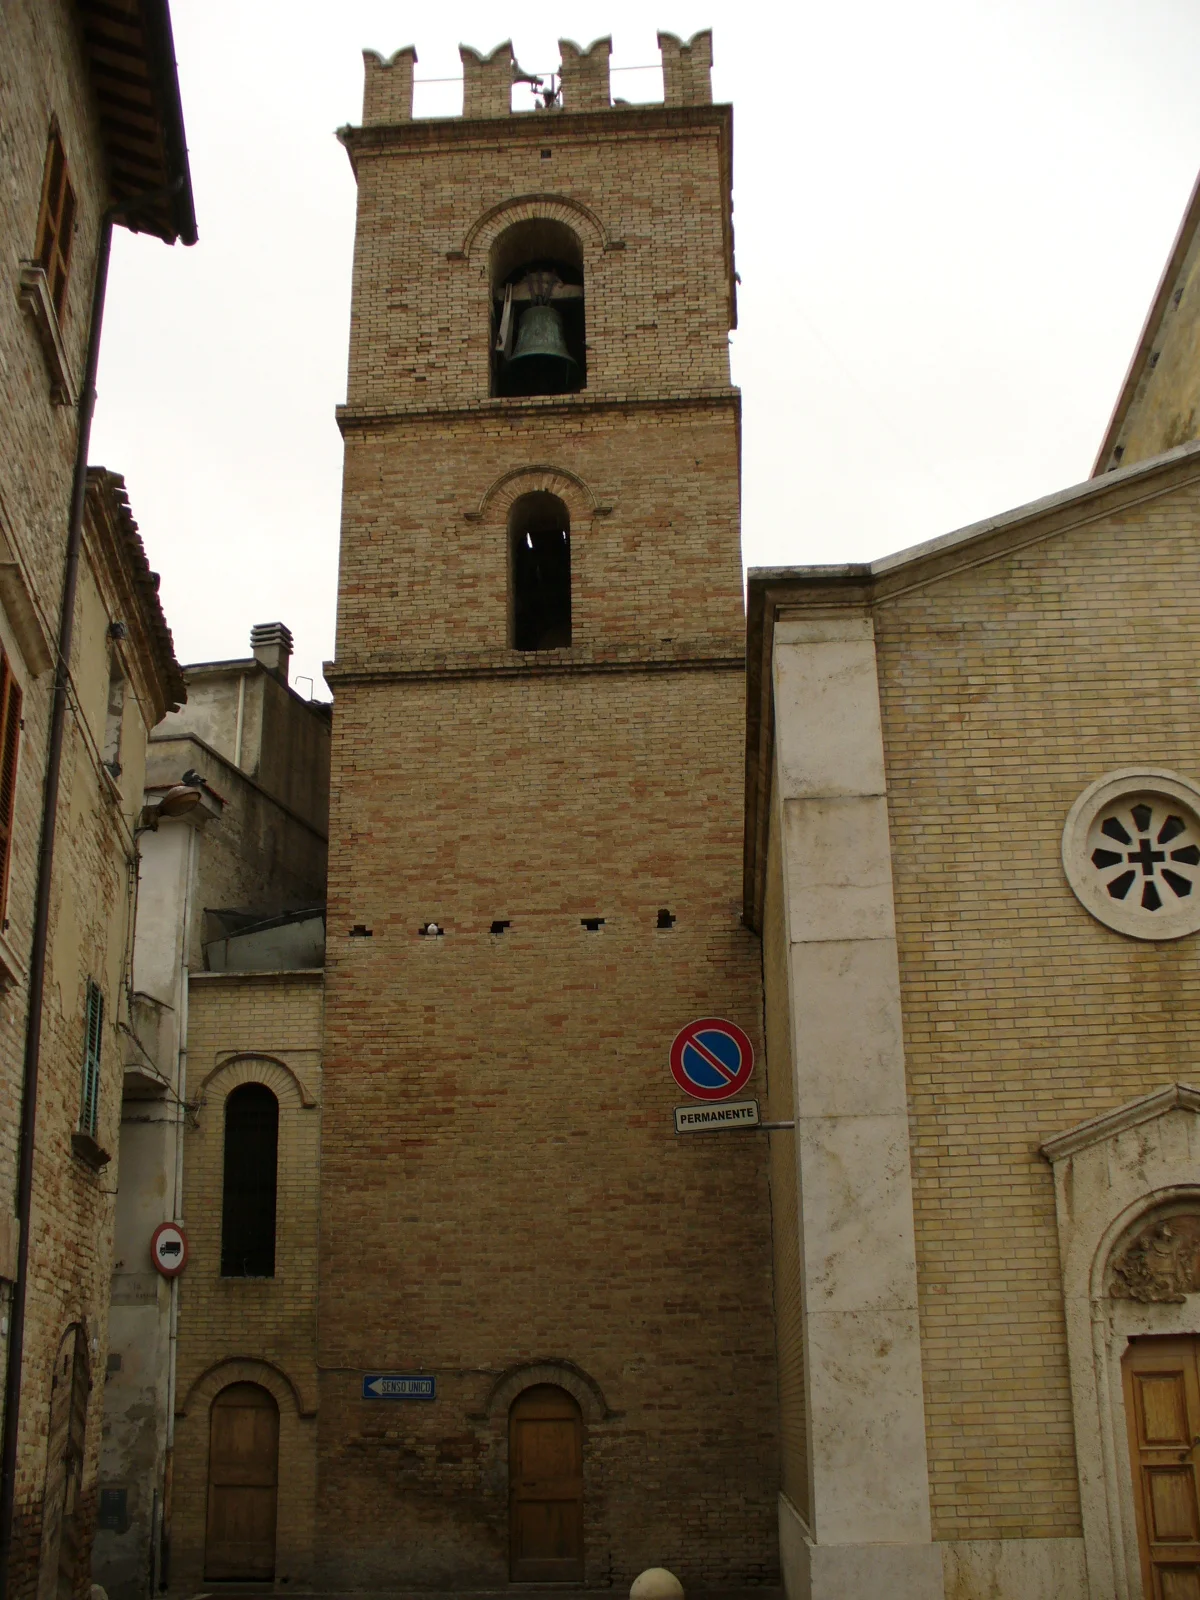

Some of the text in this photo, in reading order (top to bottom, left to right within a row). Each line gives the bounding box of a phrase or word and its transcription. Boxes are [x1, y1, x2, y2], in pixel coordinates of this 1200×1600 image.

[680, 1107, 754, 1124] PERMANENTE
[381, 1381, 431, 1393] SENSO UNICO
